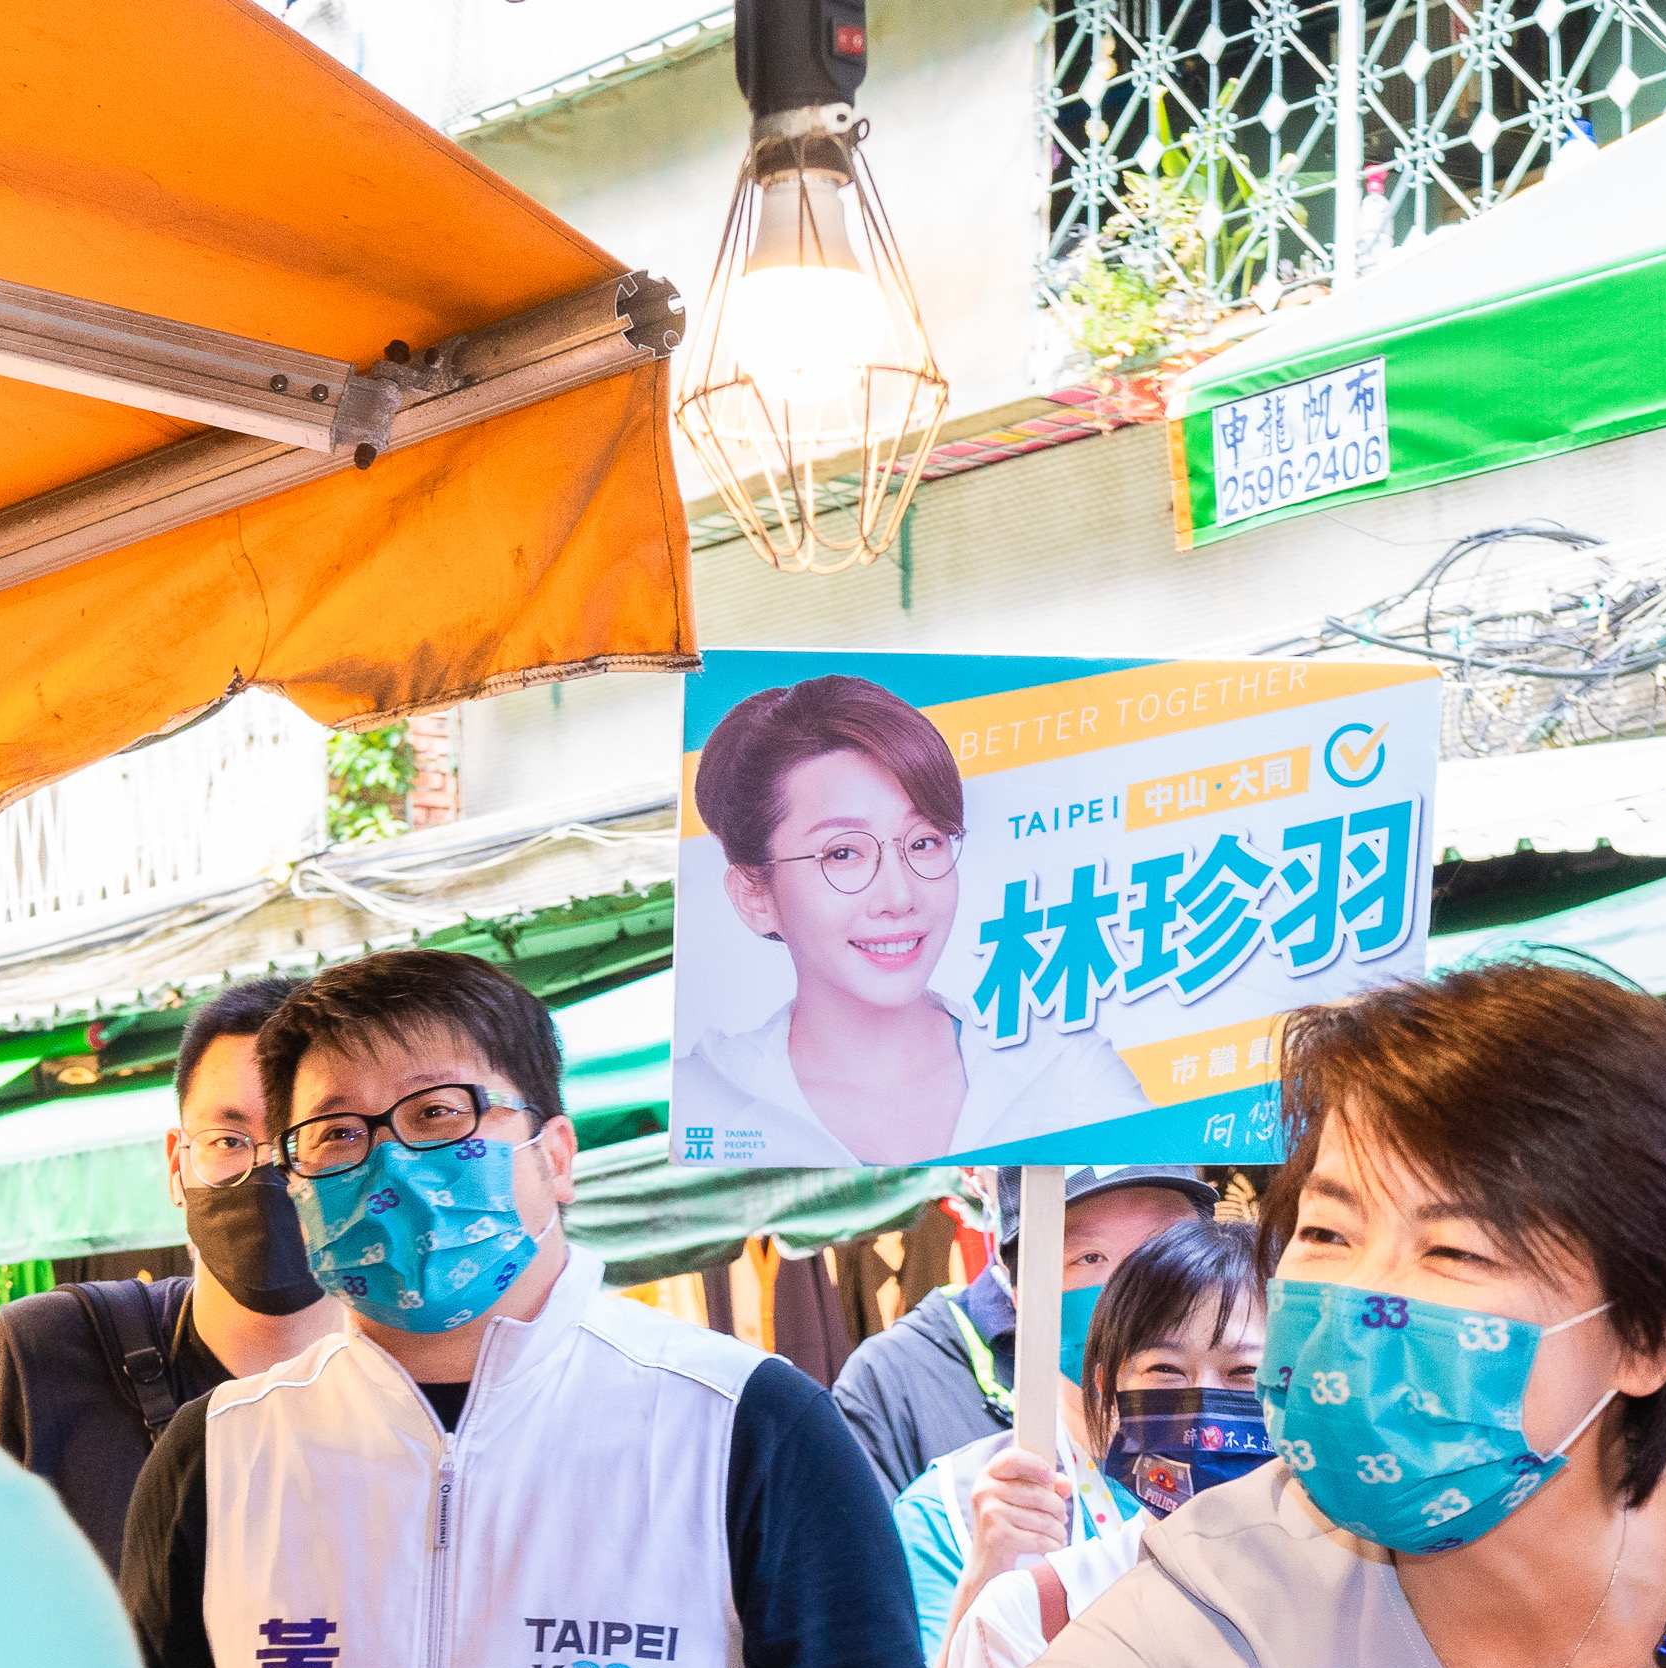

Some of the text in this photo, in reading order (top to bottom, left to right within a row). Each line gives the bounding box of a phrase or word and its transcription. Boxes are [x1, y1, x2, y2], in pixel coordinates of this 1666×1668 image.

[958, 663, 1309, 762] BETTER TOGETHER
[1008, 797, 1121, 840] TAIPEI
[972, 798, 1414, 1041] 林珍羽
[1171, 1036, 1274, 1085] 市議員
[455, 1138, 487, 1161] 33
[724, 1130, 763, 1138] TAIWAN
[724, 1140, 766, 1149] PEOPLE'S
[723, 1151, 754, 1160] PARTY
[366, 1187, 401, 1215] 33
[463, 1216, 498, 1243] 33
[343, 1275, 368, 1297] 33
[396, 1290, 425, 1310] 33
[1361, 1295, 1410, 1330] 33
[1457, 1316, 1511, 1352] 33
[1311, 1370, 1351, 1406] 33
[1279, 1438, 1317, 1472] 33
[1356, 1452, 1404, 1485] 33
[1420, 1487, 1473, 1528] 33
[524, 1617, 679, 1662] TAIPEI
